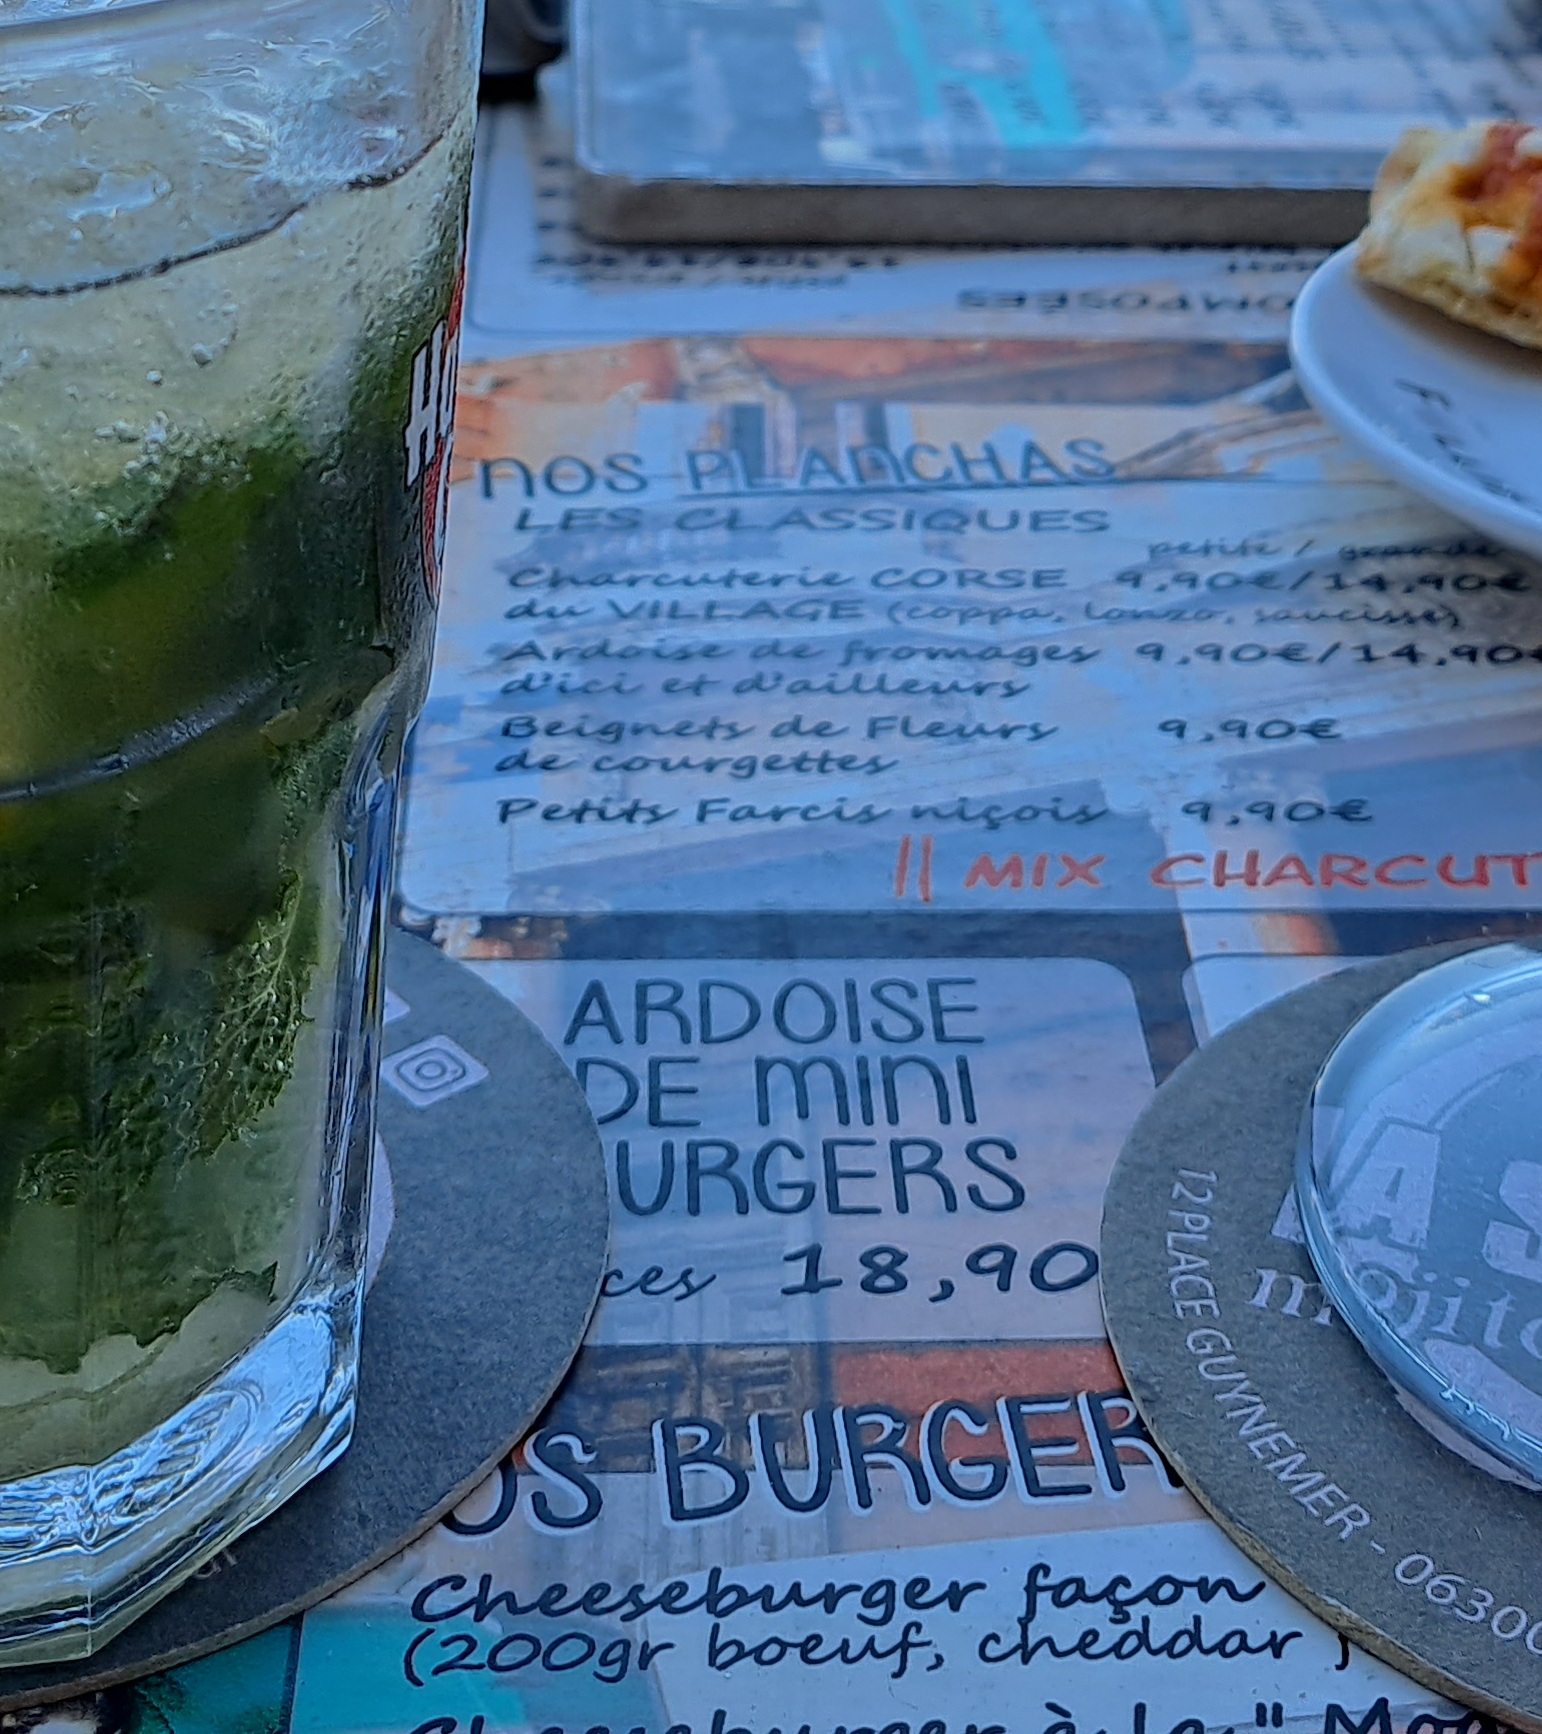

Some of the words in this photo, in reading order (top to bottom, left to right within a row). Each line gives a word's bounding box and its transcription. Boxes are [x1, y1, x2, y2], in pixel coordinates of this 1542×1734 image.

[515, 506, 643, 533] LES
[675, 506, 1110, 535] CLASSIQUES
[508, 566, 855, 592] Charcuterie
[871, 567, 1067, 590] CORSE
[506, 600, 593, 622] du
[608, 599, 866, 622] VILLAGE
[501, 637, 738, 664] Ardoise
[750, 637, 826, 659] de
[842, 640, 1102, 667] fromages
[662, 674, 722, 695] et
[500, 714, 757, 745] Beignets
[770, 714, 850, 739] de
[865, 714, 1059, 742] Fleurs
[495, 750, 576, 773] de
[594, 751, 900, 780] courgettes
[497, 797, 680, 826] Petits
[695, 797, 892, 825] Farcis
[909, 797, 1108, 831] niçois
[964, 853, 1105, 889] MIX
[563, 977, 986, 1045] ARDOISE
[575, 1055, 702, 1128] DE
[615, 1136, 1027, 1216] URGERS
[1165, 1209, 1223, 1321] PLACE
[1185, 1326, 1372, 1542] GUYNEMER
[411, 1566, 990, 1628] Cheeseburger
[1024, 1562, 1266, 1624] façon
[402, 1627, 676, 1688] (200gr
[707, 1621, 946, 1679] boeuf,
[978, 1615, 1305, 1667] cheddar
